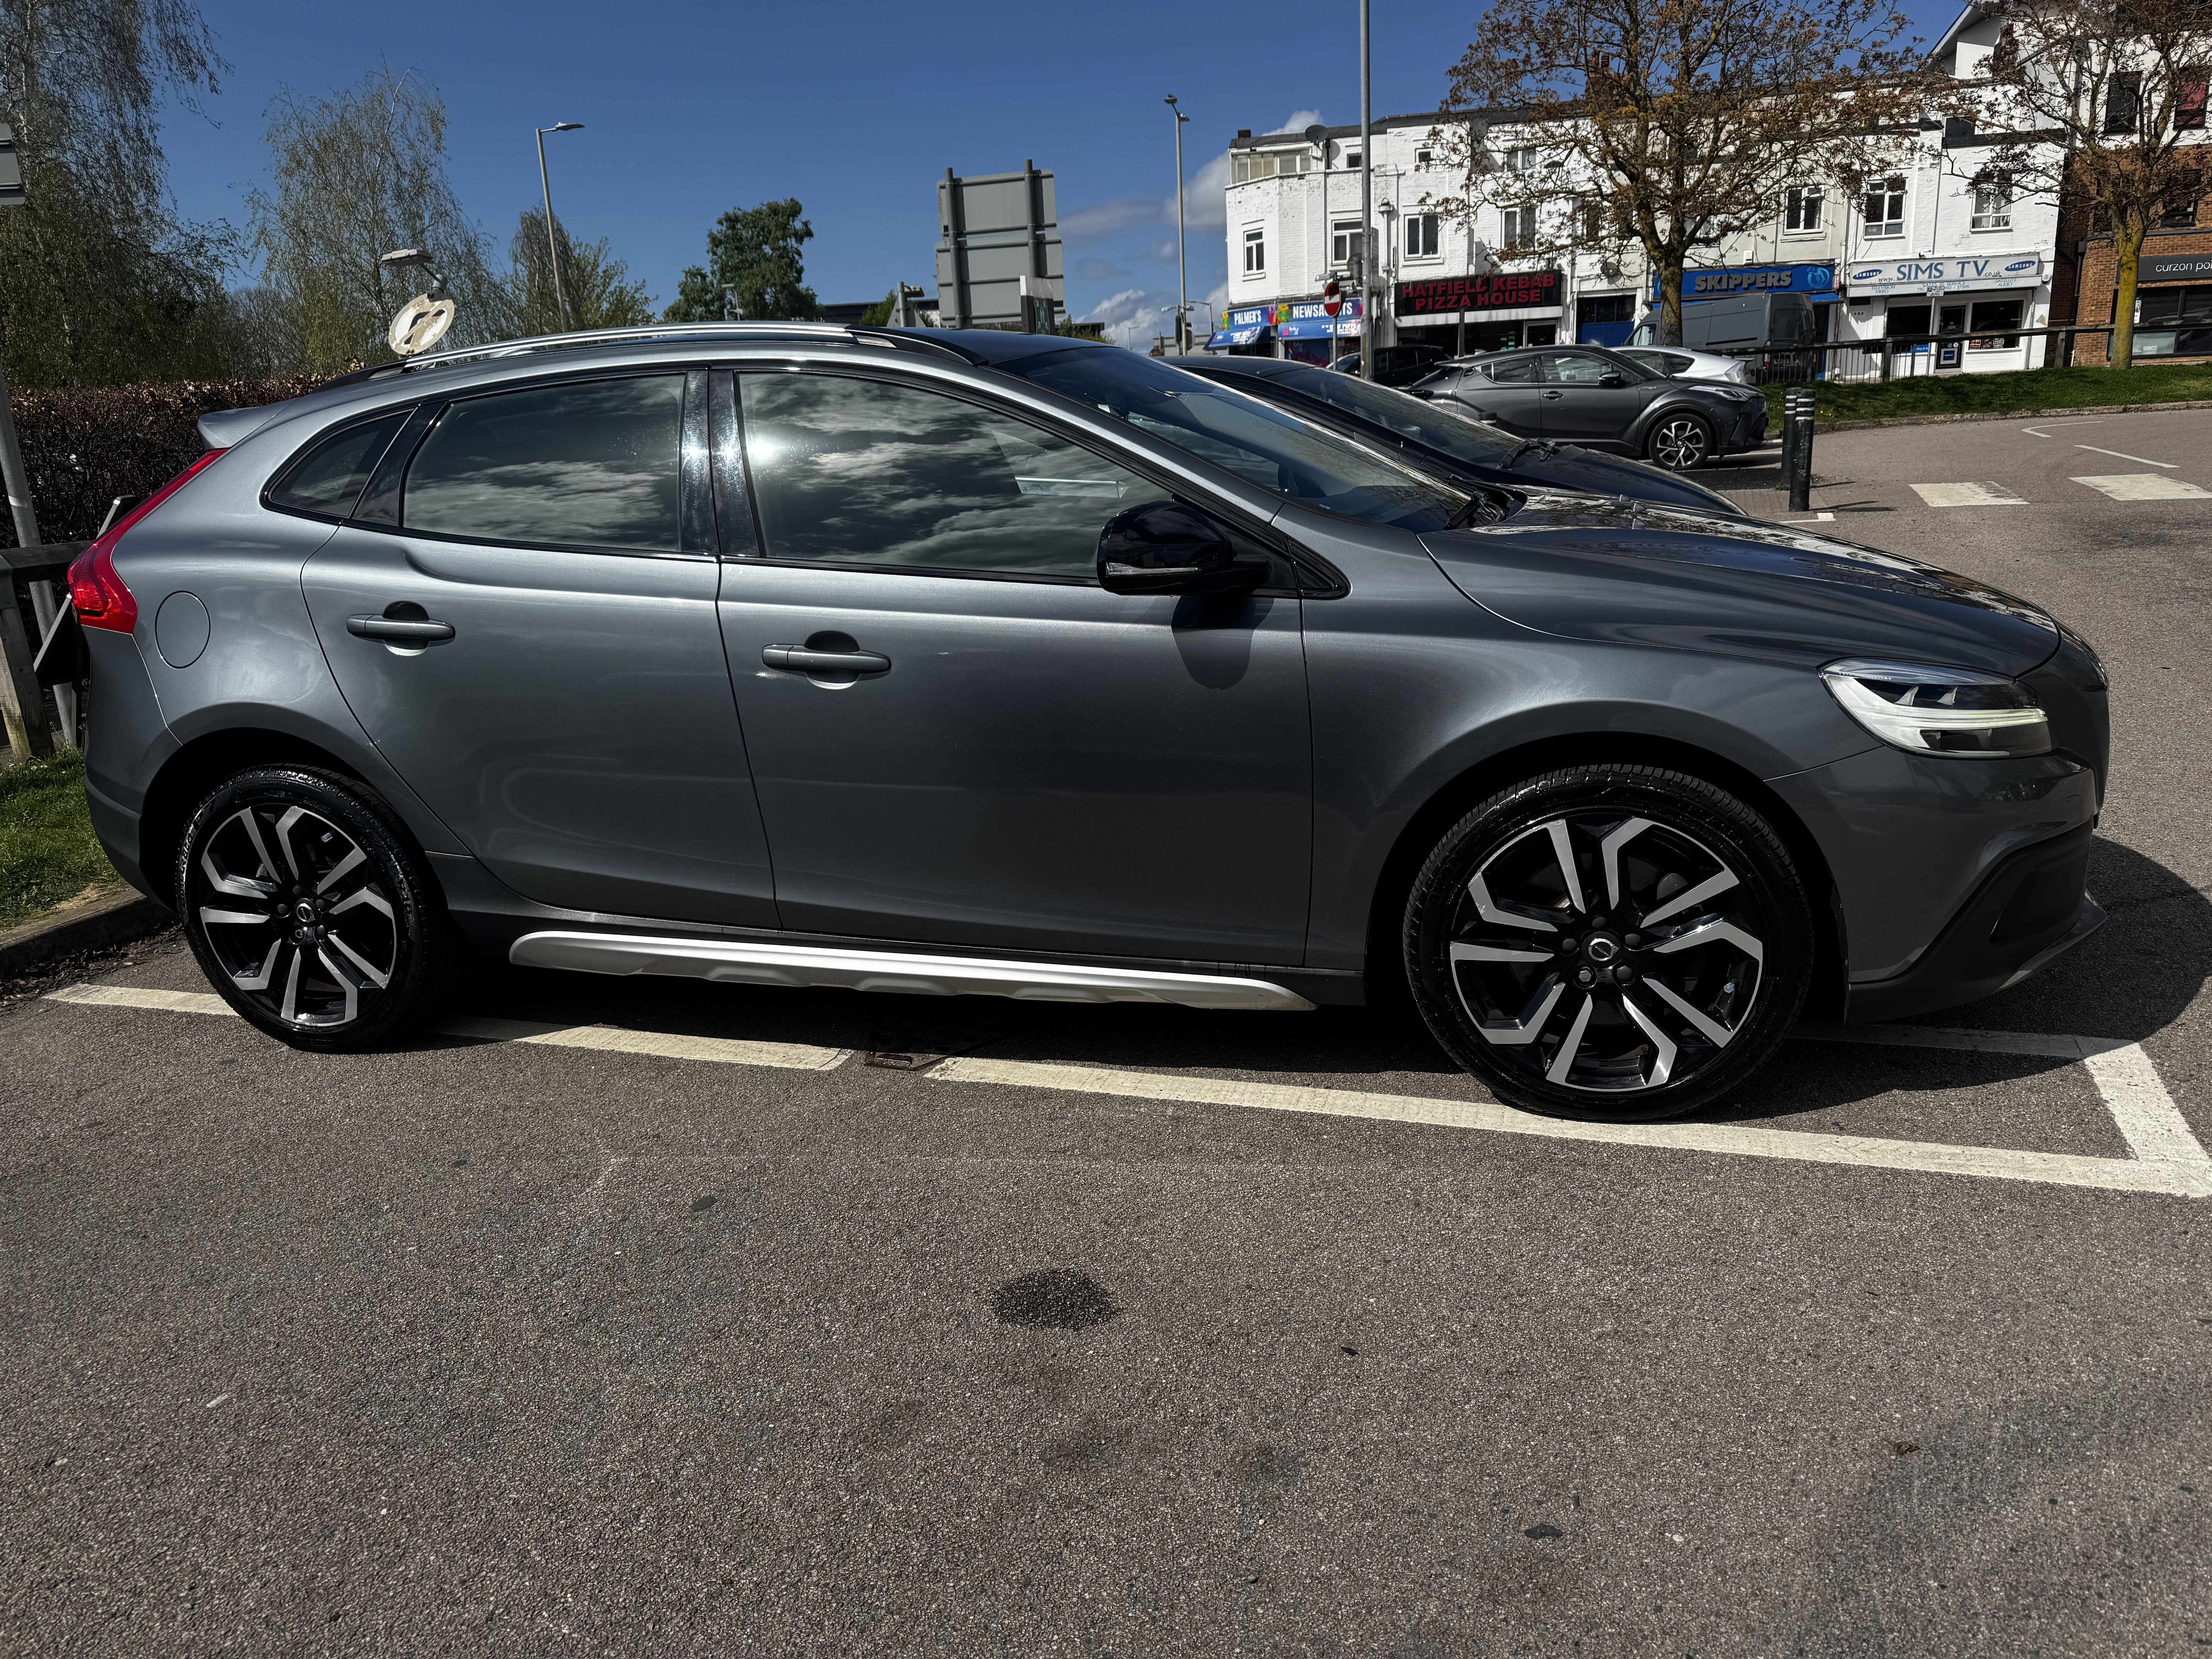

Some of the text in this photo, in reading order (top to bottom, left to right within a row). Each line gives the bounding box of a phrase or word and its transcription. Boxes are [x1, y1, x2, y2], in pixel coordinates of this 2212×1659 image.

[1897, 262, 1944, 281] SIMS
[1956, 259, 1990, 278] TV
[2156, 263, 2192, 272] curzon
[1402, 275, 1555, 298] HATFIELD KEBAB
[1695, 271, 1791, 290] SKIPPERS
[1416, 289, 1540, 311] PIZZA HOUSE
[1234, 310, 1261, 325] PALMER'S
[1293, 302, 1353, 318] NEWSATS
